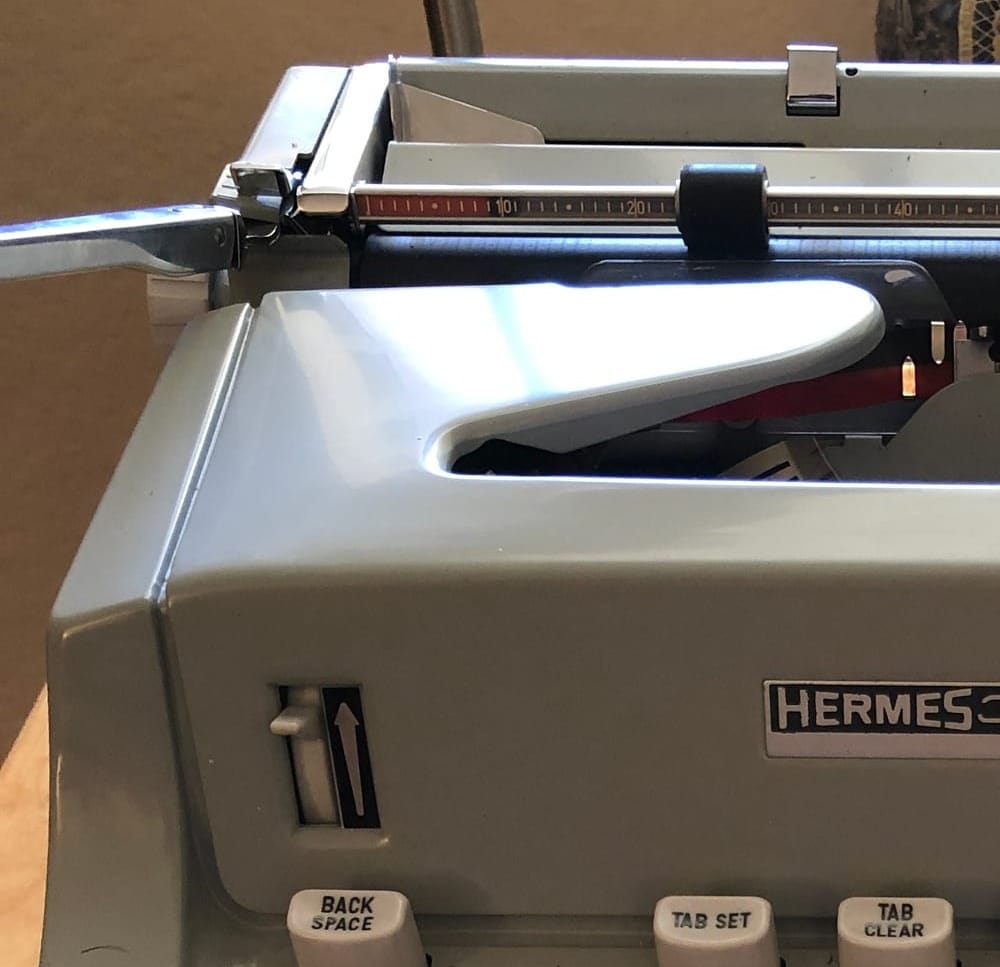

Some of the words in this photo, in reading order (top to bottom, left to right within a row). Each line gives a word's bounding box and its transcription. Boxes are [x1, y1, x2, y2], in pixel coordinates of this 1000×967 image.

[627, 200, 645, 215] 20
[894, 202, 912, 217] 40
[777, 687, 973, 731] HERMES
[320, 895, 375, 915] BACK
[877, 902, 914, 922] TAB
[311, 916, 375, 932] SPACE
[671, 911, 709, 930] TAB
[715, 911, 752, 930] SET
[864, 922, 925, 938] CLEAR
